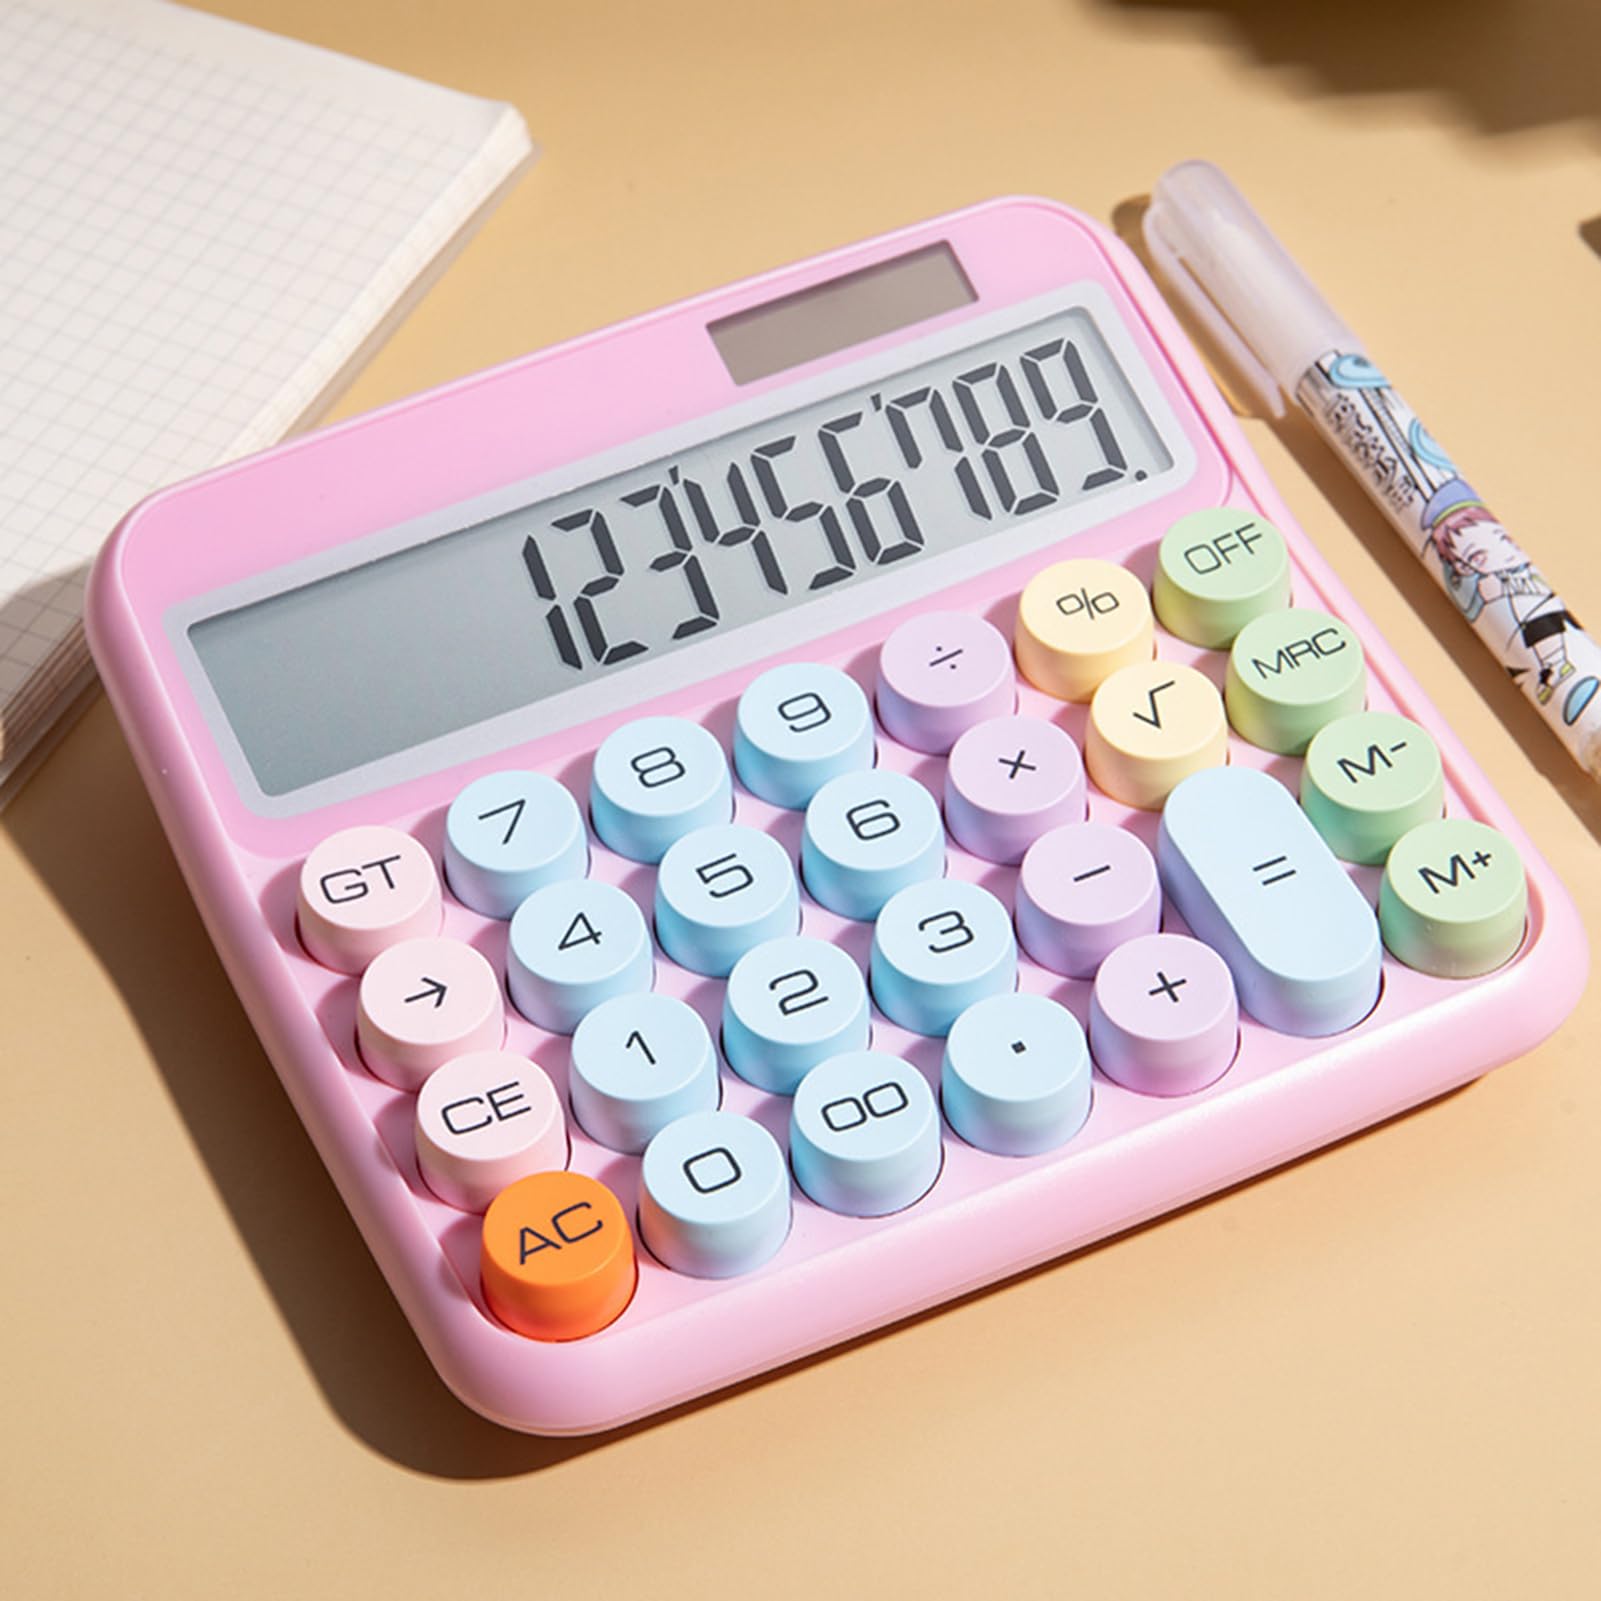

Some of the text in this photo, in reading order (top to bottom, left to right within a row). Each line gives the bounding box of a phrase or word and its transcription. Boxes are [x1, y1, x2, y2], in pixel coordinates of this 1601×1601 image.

[1183, 522, 1262, 575] OFF
[1252, 628, 1347, 679] MRC
[777, 692, 832, 733] 9
[630, 746, 686, 788] 8
[478, 799, 526, 845] 7
[846, 799, 901, 841] 6
[319, 855, 401, 904] GT
[695, 853, 754, 899] 5
[1418, 851, 1492, 894] M+
[558, 912, 602, 951] 4
[918, 910, 974, 954] 3
[769, 969, 829, 1016] 2
[625, 1030, 656, 1065] 1
[441, 1081, 532, 1135] CE
[518, 1201, 604, 1265] AC
